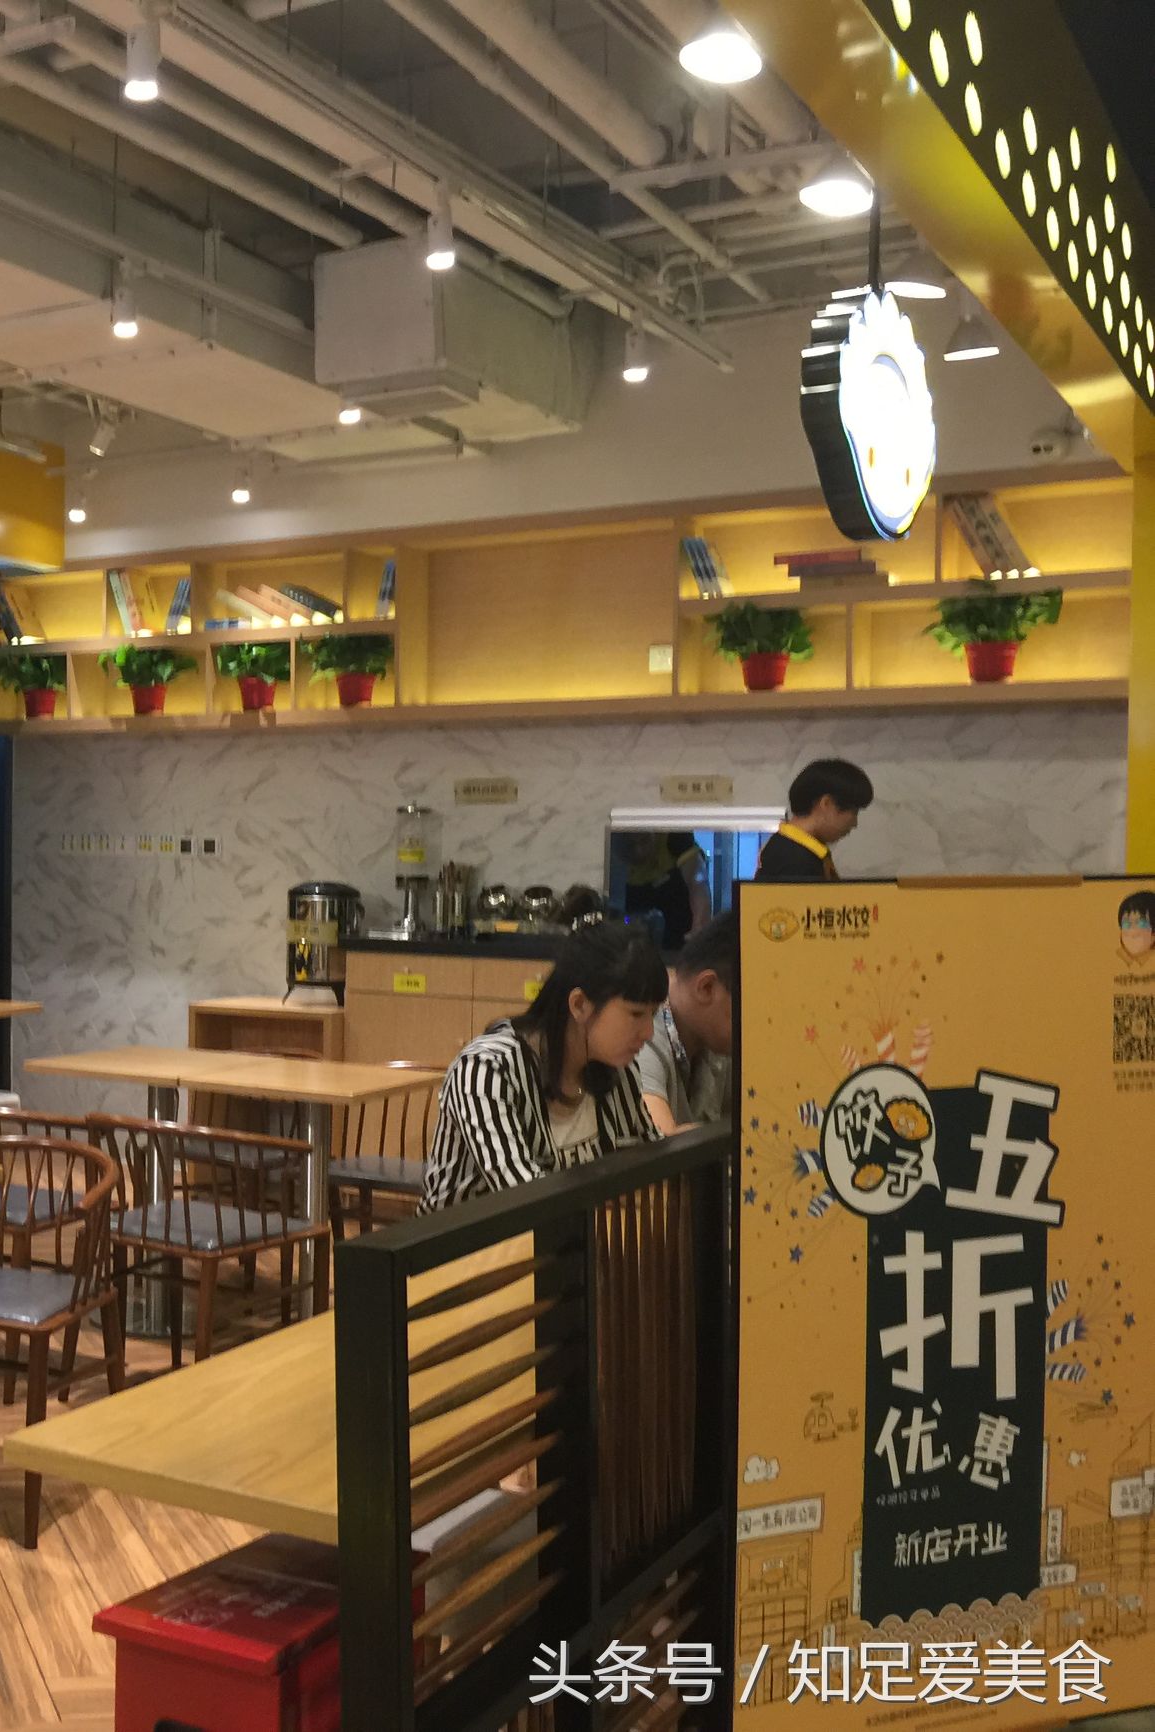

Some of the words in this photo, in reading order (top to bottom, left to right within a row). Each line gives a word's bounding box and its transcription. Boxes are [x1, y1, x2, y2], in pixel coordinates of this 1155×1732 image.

[801, 904, 870, 930] 小恒水饺
[835, 1090, 922, 1196] 饺子
[875, 1399, 1021, 1491] 优惠
[894, 1521, 1007, 1568] 新店开业
